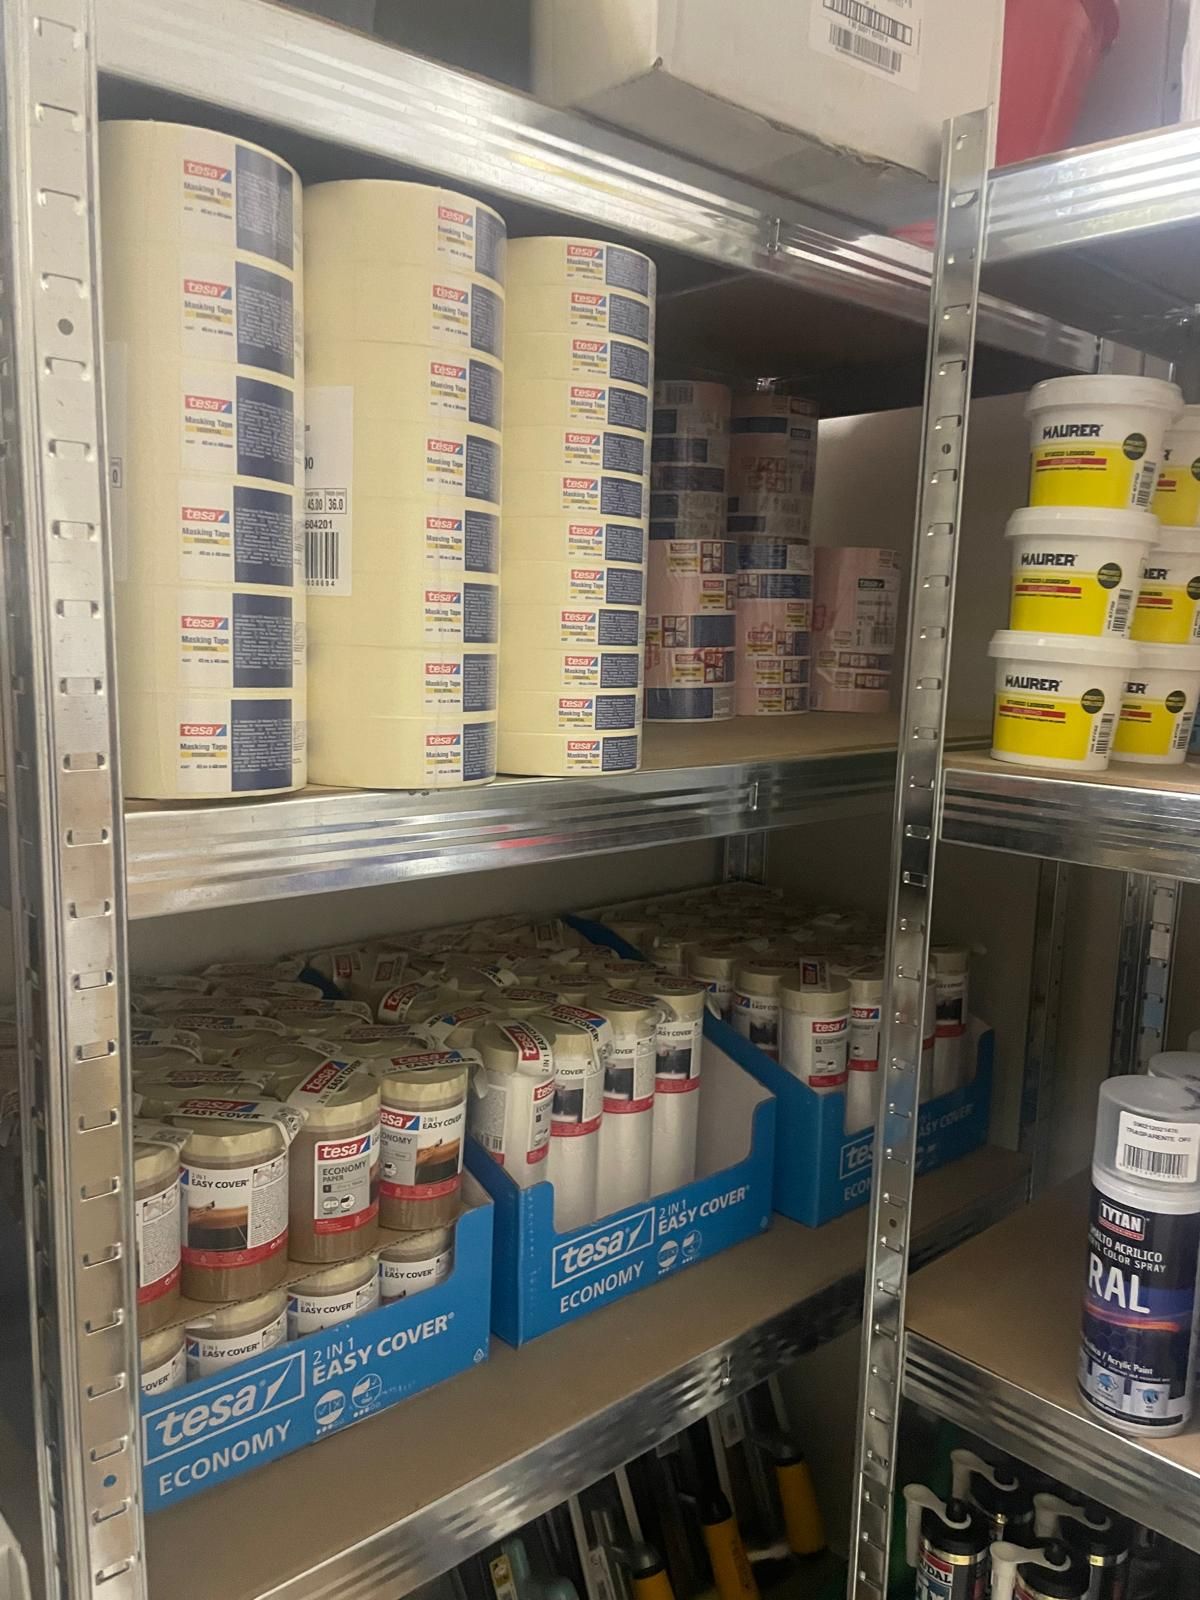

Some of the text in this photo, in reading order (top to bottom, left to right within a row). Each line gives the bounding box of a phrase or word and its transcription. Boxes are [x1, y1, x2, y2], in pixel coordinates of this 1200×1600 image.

[187, 162, 217, 178] tesa
[184, 181, 214, 196] Masking
[217, 188, 232, 199] Tape
[441, 208, 464, 222] tesa
[570, 246, 593, 257] tesa
[567, 258, 590, 267] Masking
[188, 282, 218, 297] tesa
[436, 287, 460, 300] tesa
[574, 294, 596, 304] tesa
[184, 300, 232, 315] Masking Tape
[433, 303, 468, 317] Masking Tape
[571, 306, 593, 315] Masking
[575, 341, 598, 351] tesa
[573, 352, 594, 361] Masking
[434, 364, 458, 377] tesa
[455, 385, 466, 394] Tape
[574, 388, 596, 398] tesa
[189, 397, 218, 410] tesa
[571, 399, 605, 409] Masking Tape
[185, 416, 232, 429] Masking Tape
[1043, 424, 1101, 439] MAURER
[568, 434, 590, 443] tesa
[430, 441, 455, 452] tesa
[565, 446, 587, 454] Masking
[427, 457, 463, 469] Masking Tape
[566, 479, 588, 488] tesa
[563, 490, 585, 498] Masking
[185, 508, 215, 520] tesa
[429, 518, 454, 528] tesa
[182, 528, 230, 538] Masking Tape
[571, 526, 593, 535] tesa
[451, 536, 462, 544] Tape
[569, 537, 590, 545] Masking
[1021, 553, 1075, 566] MAURER
[574, 571, 595, 579] tesa
[428, 592, 452, 602] tesa
[425, 608, 448, 617] Masking
[564, 613, 586, 621] tesa
[185, 617, 215, 628] tesa
[182, 636, 229, 645] Masking Tape
[428, 664, 452, 674] tesa
[426, 679, 460, 688] Masking Tape
[1005, 675, 1060, 692] MAURER
[561, 699, 582, 707] tesa
[183, 725, 213, 736] tesa
[429, 736, 452, 745] tesa
[570, 742, 590, 750] tesa
[180, 743, 210, 751] Masking
[426, 751, 450, 759] Masking
[552, 1012, 600, 1042] EASY COVER
[815, 1023, 841, 1032] tesa
[307, 1068, 334, 1091] tesa
[327, 1074, 346, 1090] EASY
[381, 1112, 403, 1127] esa
[918, 1103, 974, 1138] ASY COVER
[321, 1144, 358, 1158] tesa
[847, 1143, 872, 1169] tes
[323, 1161, 366, 1175] ECONOMY
[192, 1179, 247, 1188] EASY COVER
[658, 1186, 746, 1235] EASY COVER
[659, 1200, 687, 1220] 2 IN 1
[1102, 1203, 1142, 1232] TYTAN
[560, 1228, 624, 1274] tesa
[1114, 1241, 1163, 1263] ACRILICO
[1103, 1247, 1166, 1273] COLOR SPRAY
[406, 1270, 433, 1279] COVER
[560, 1261, 644, 1313] ECONOMY
[1088, 1251, 1150, 1314] RAL
[301, 1303, 351, 1314] EASY COVER
[227, 1343, 257, 1356] COVER
[312, 1314, 450, 1386] EASY COVER
[313, 1336, 355, 1366] 2 IN 1
[1133, 1364, 1153, 1374] Paint
[155, 1383, 257, 1447] tesa
[160, 1419, 291, 1497] ECONOMY
